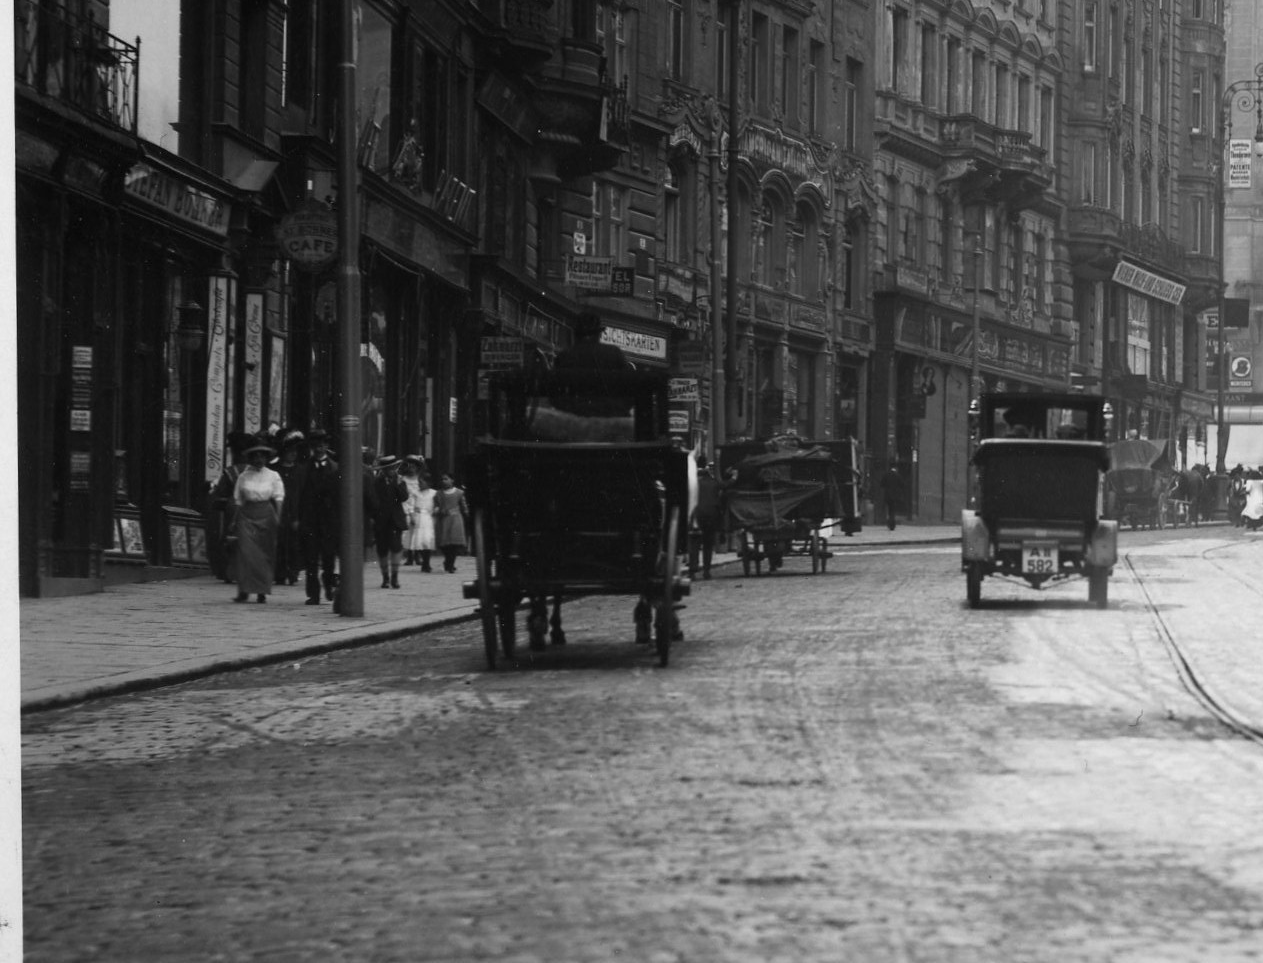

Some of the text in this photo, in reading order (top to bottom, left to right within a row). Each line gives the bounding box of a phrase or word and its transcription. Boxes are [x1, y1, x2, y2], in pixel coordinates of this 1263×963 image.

[567, 256, 612, 276] Restaurant
[602, 328, 660, 352] SICHTSKARTEN
[1030, 547, 1039, 556] A
[1027, 558, 1053, 573] 582
